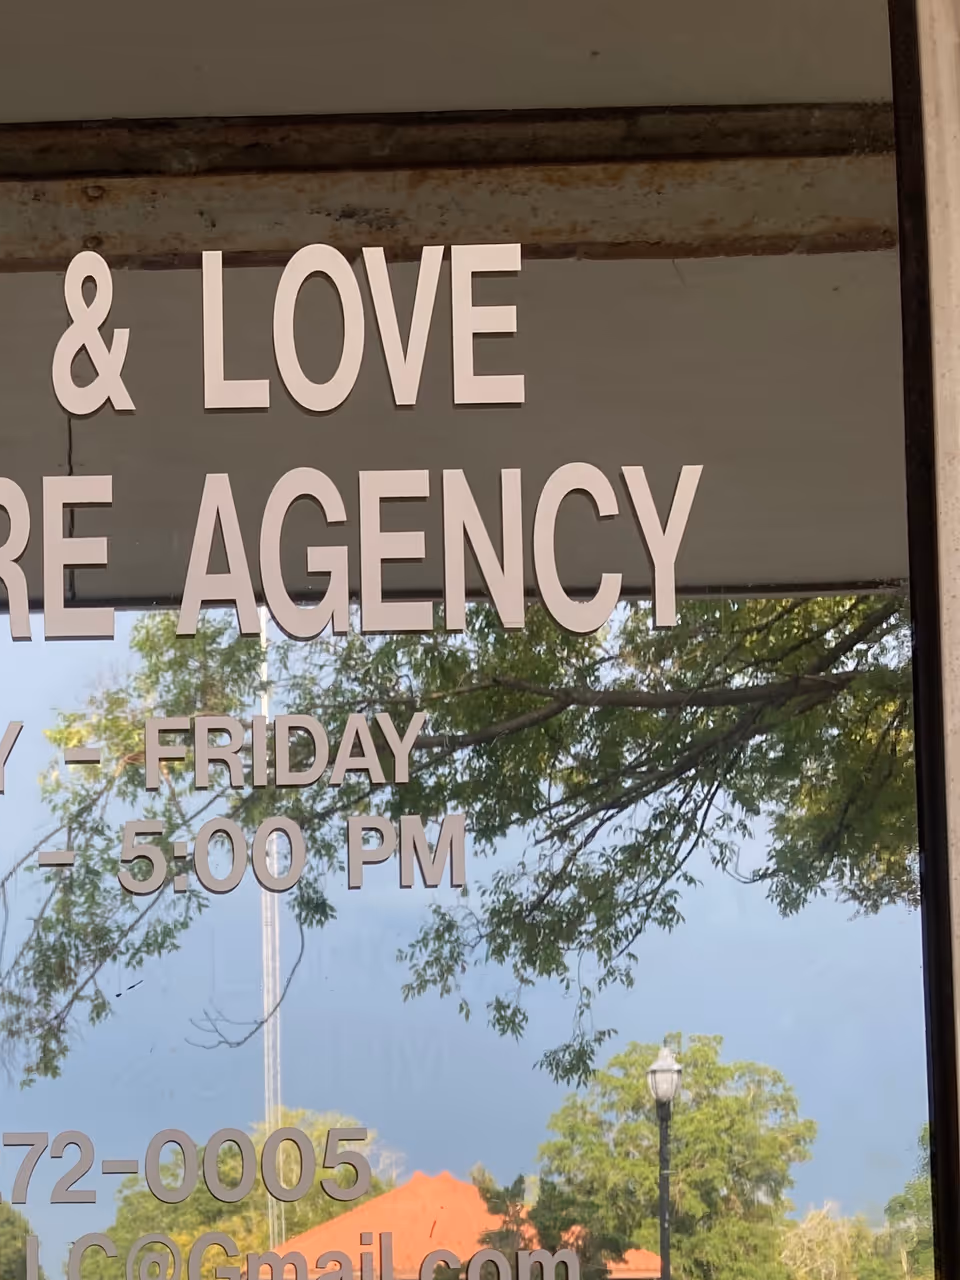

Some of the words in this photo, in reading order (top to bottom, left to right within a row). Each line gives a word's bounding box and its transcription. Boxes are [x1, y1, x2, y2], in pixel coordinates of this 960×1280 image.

[52, 250, 136, 415] &
[202, 243, 525, 411] LOVE
[176, 462, 703, 638] AGENCY
[64, 748, 101, 764] -
[144, 712, 427, 791] FRIDAY
[38, 851, 74, 867] -
[117, 816, 307, 895] 5:00
[347, 814, 466, 889] PM
